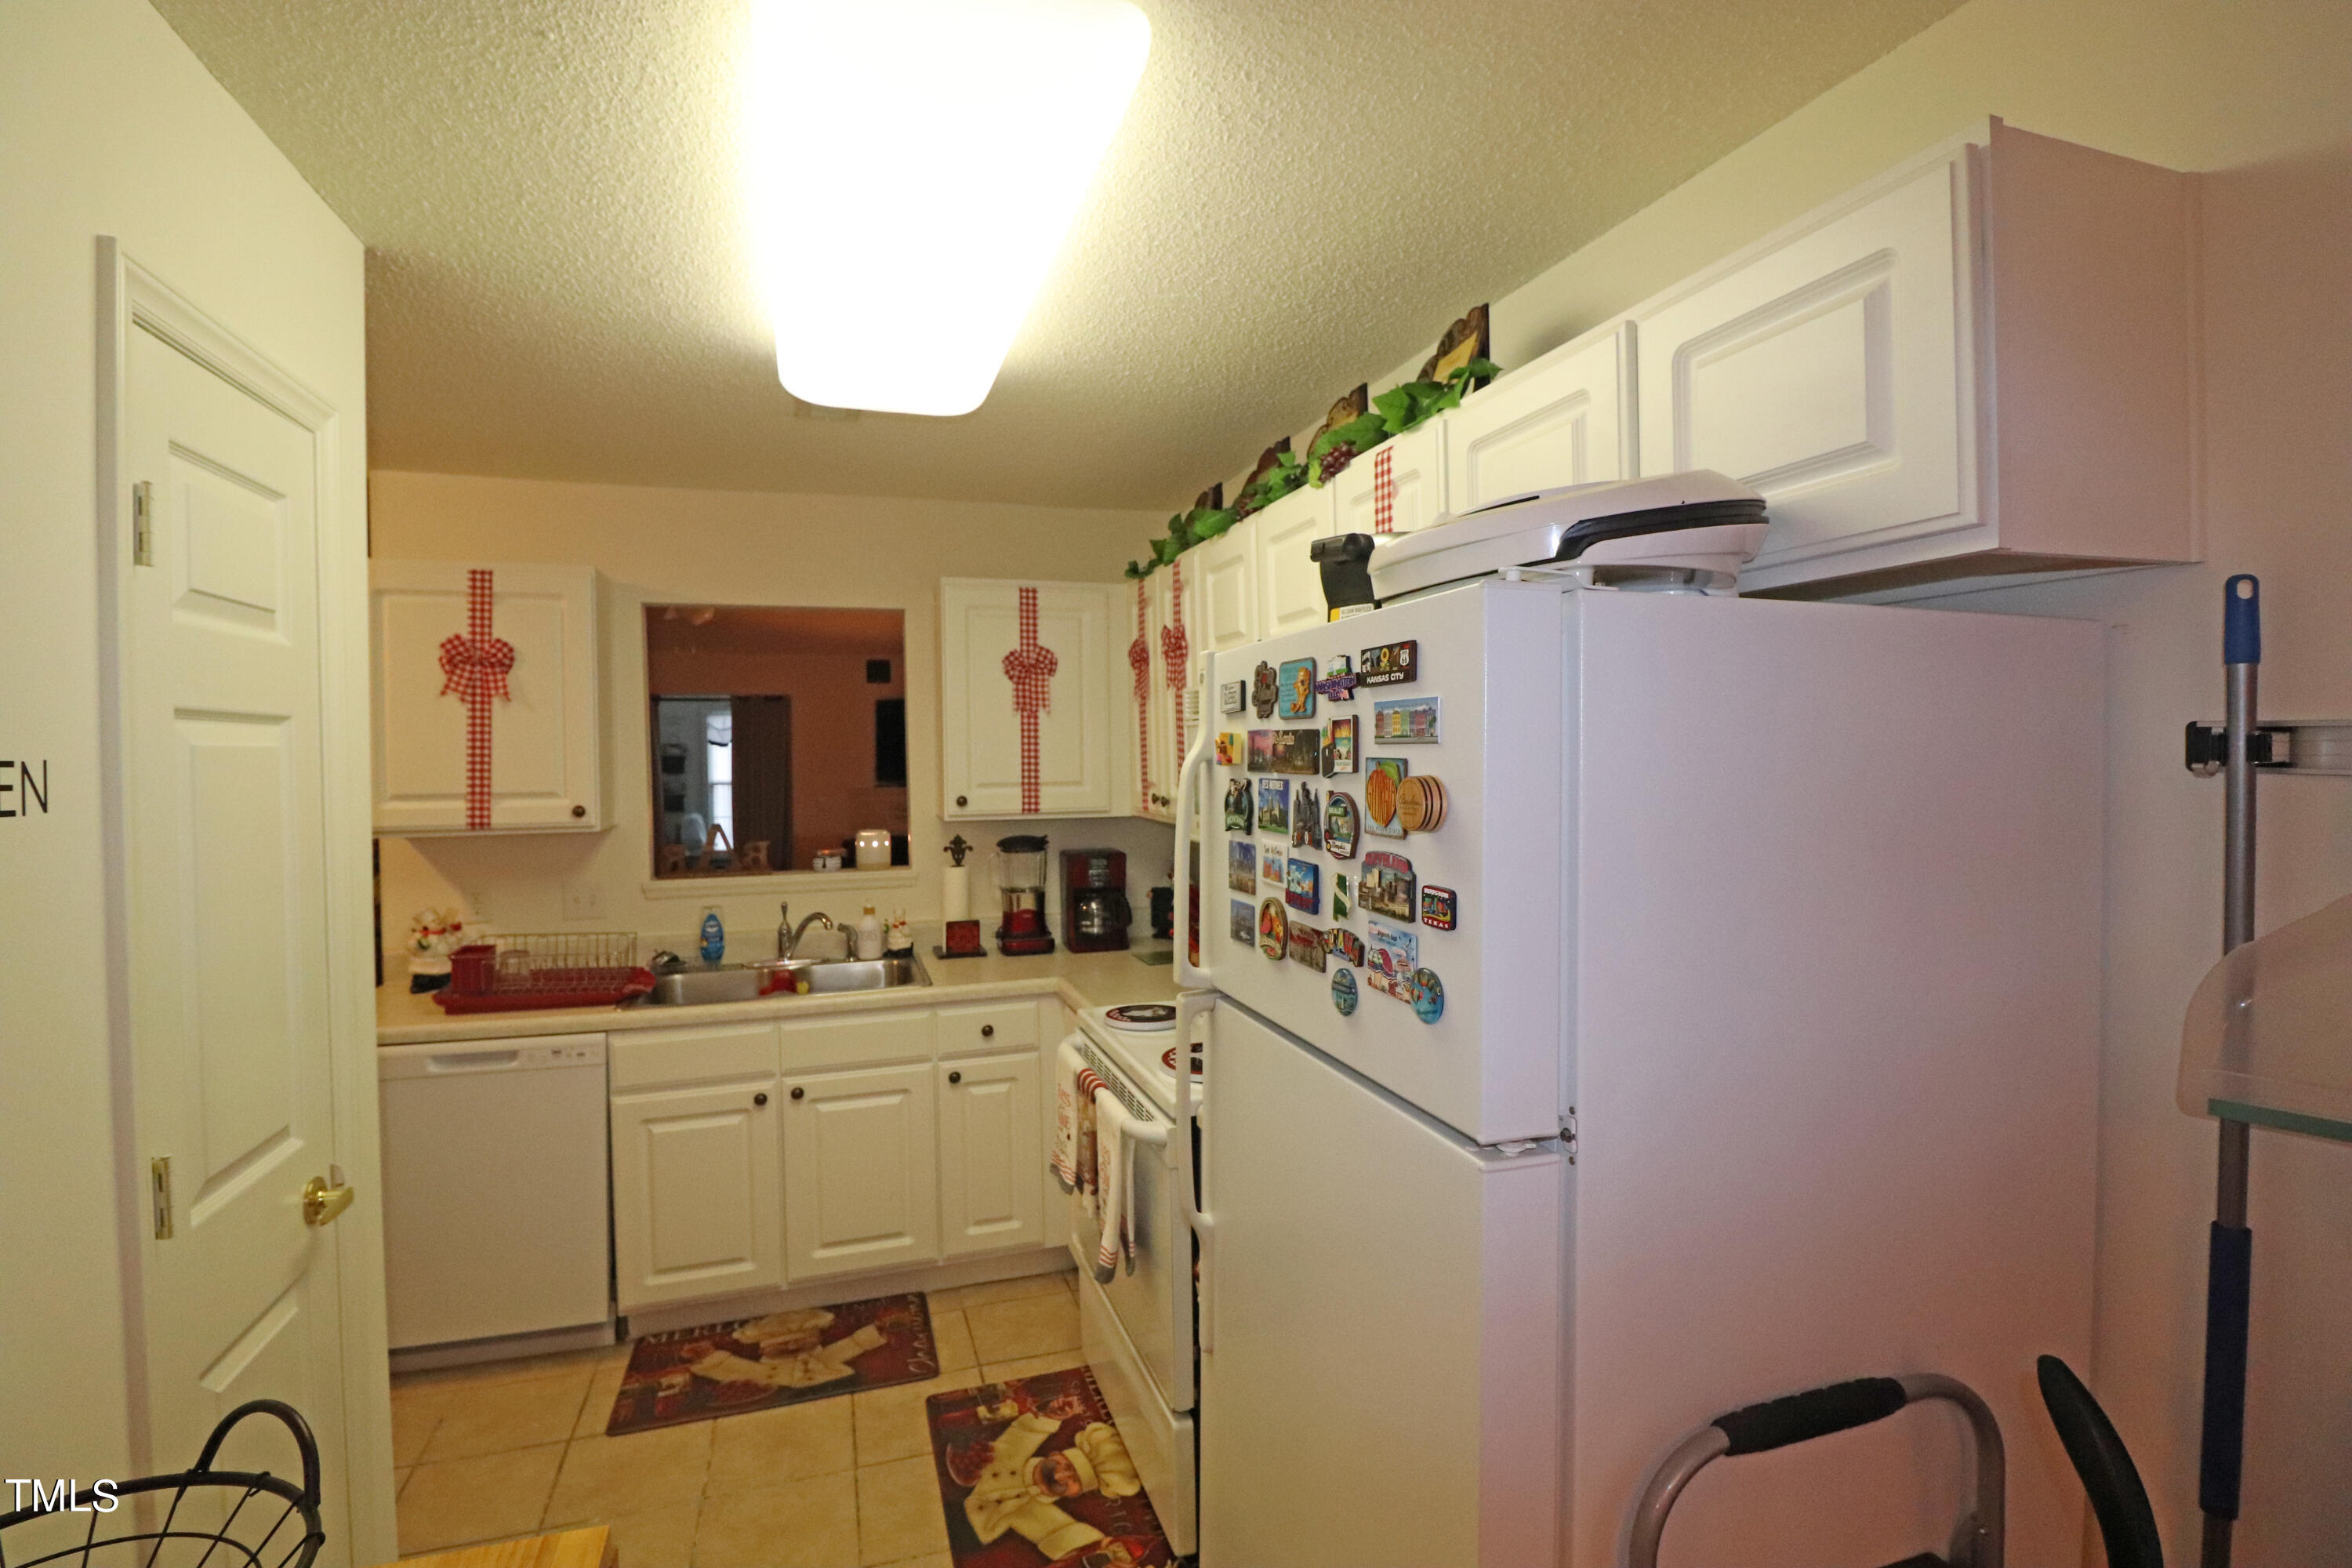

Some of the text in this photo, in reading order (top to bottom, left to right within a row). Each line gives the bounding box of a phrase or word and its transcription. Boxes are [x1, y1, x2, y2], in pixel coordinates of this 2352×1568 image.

[1367, 672, 1404, 684] KANSAS CITY
[1423, 917, 1449, 929] TEXAS
